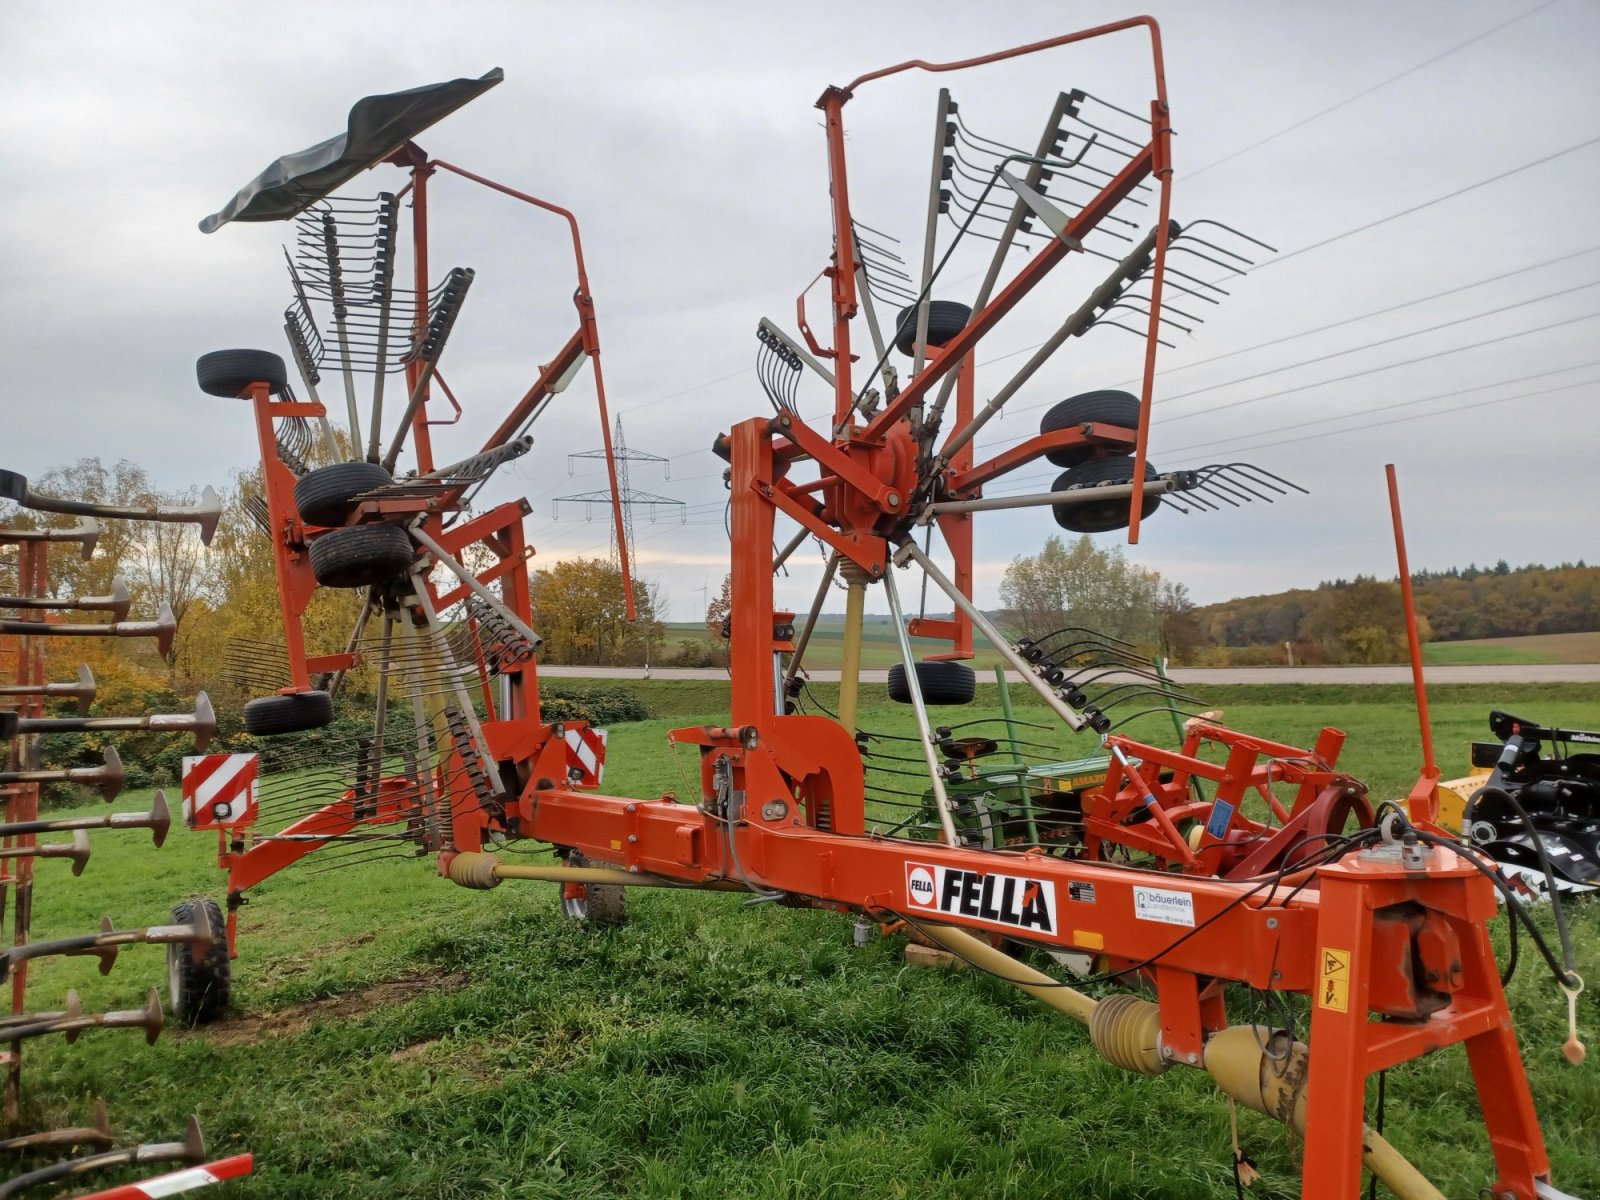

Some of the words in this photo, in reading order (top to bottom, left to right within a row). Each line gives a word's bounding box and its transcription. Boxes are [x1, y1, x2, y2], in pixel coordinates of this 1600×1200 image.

[1073, 773, 1107, 786] AMAZO
[911, 879, 932, 893] FELLA
[941, 869, 1052, 932] FELLA
[1149, 892, 1191, 907] bäuerlein
